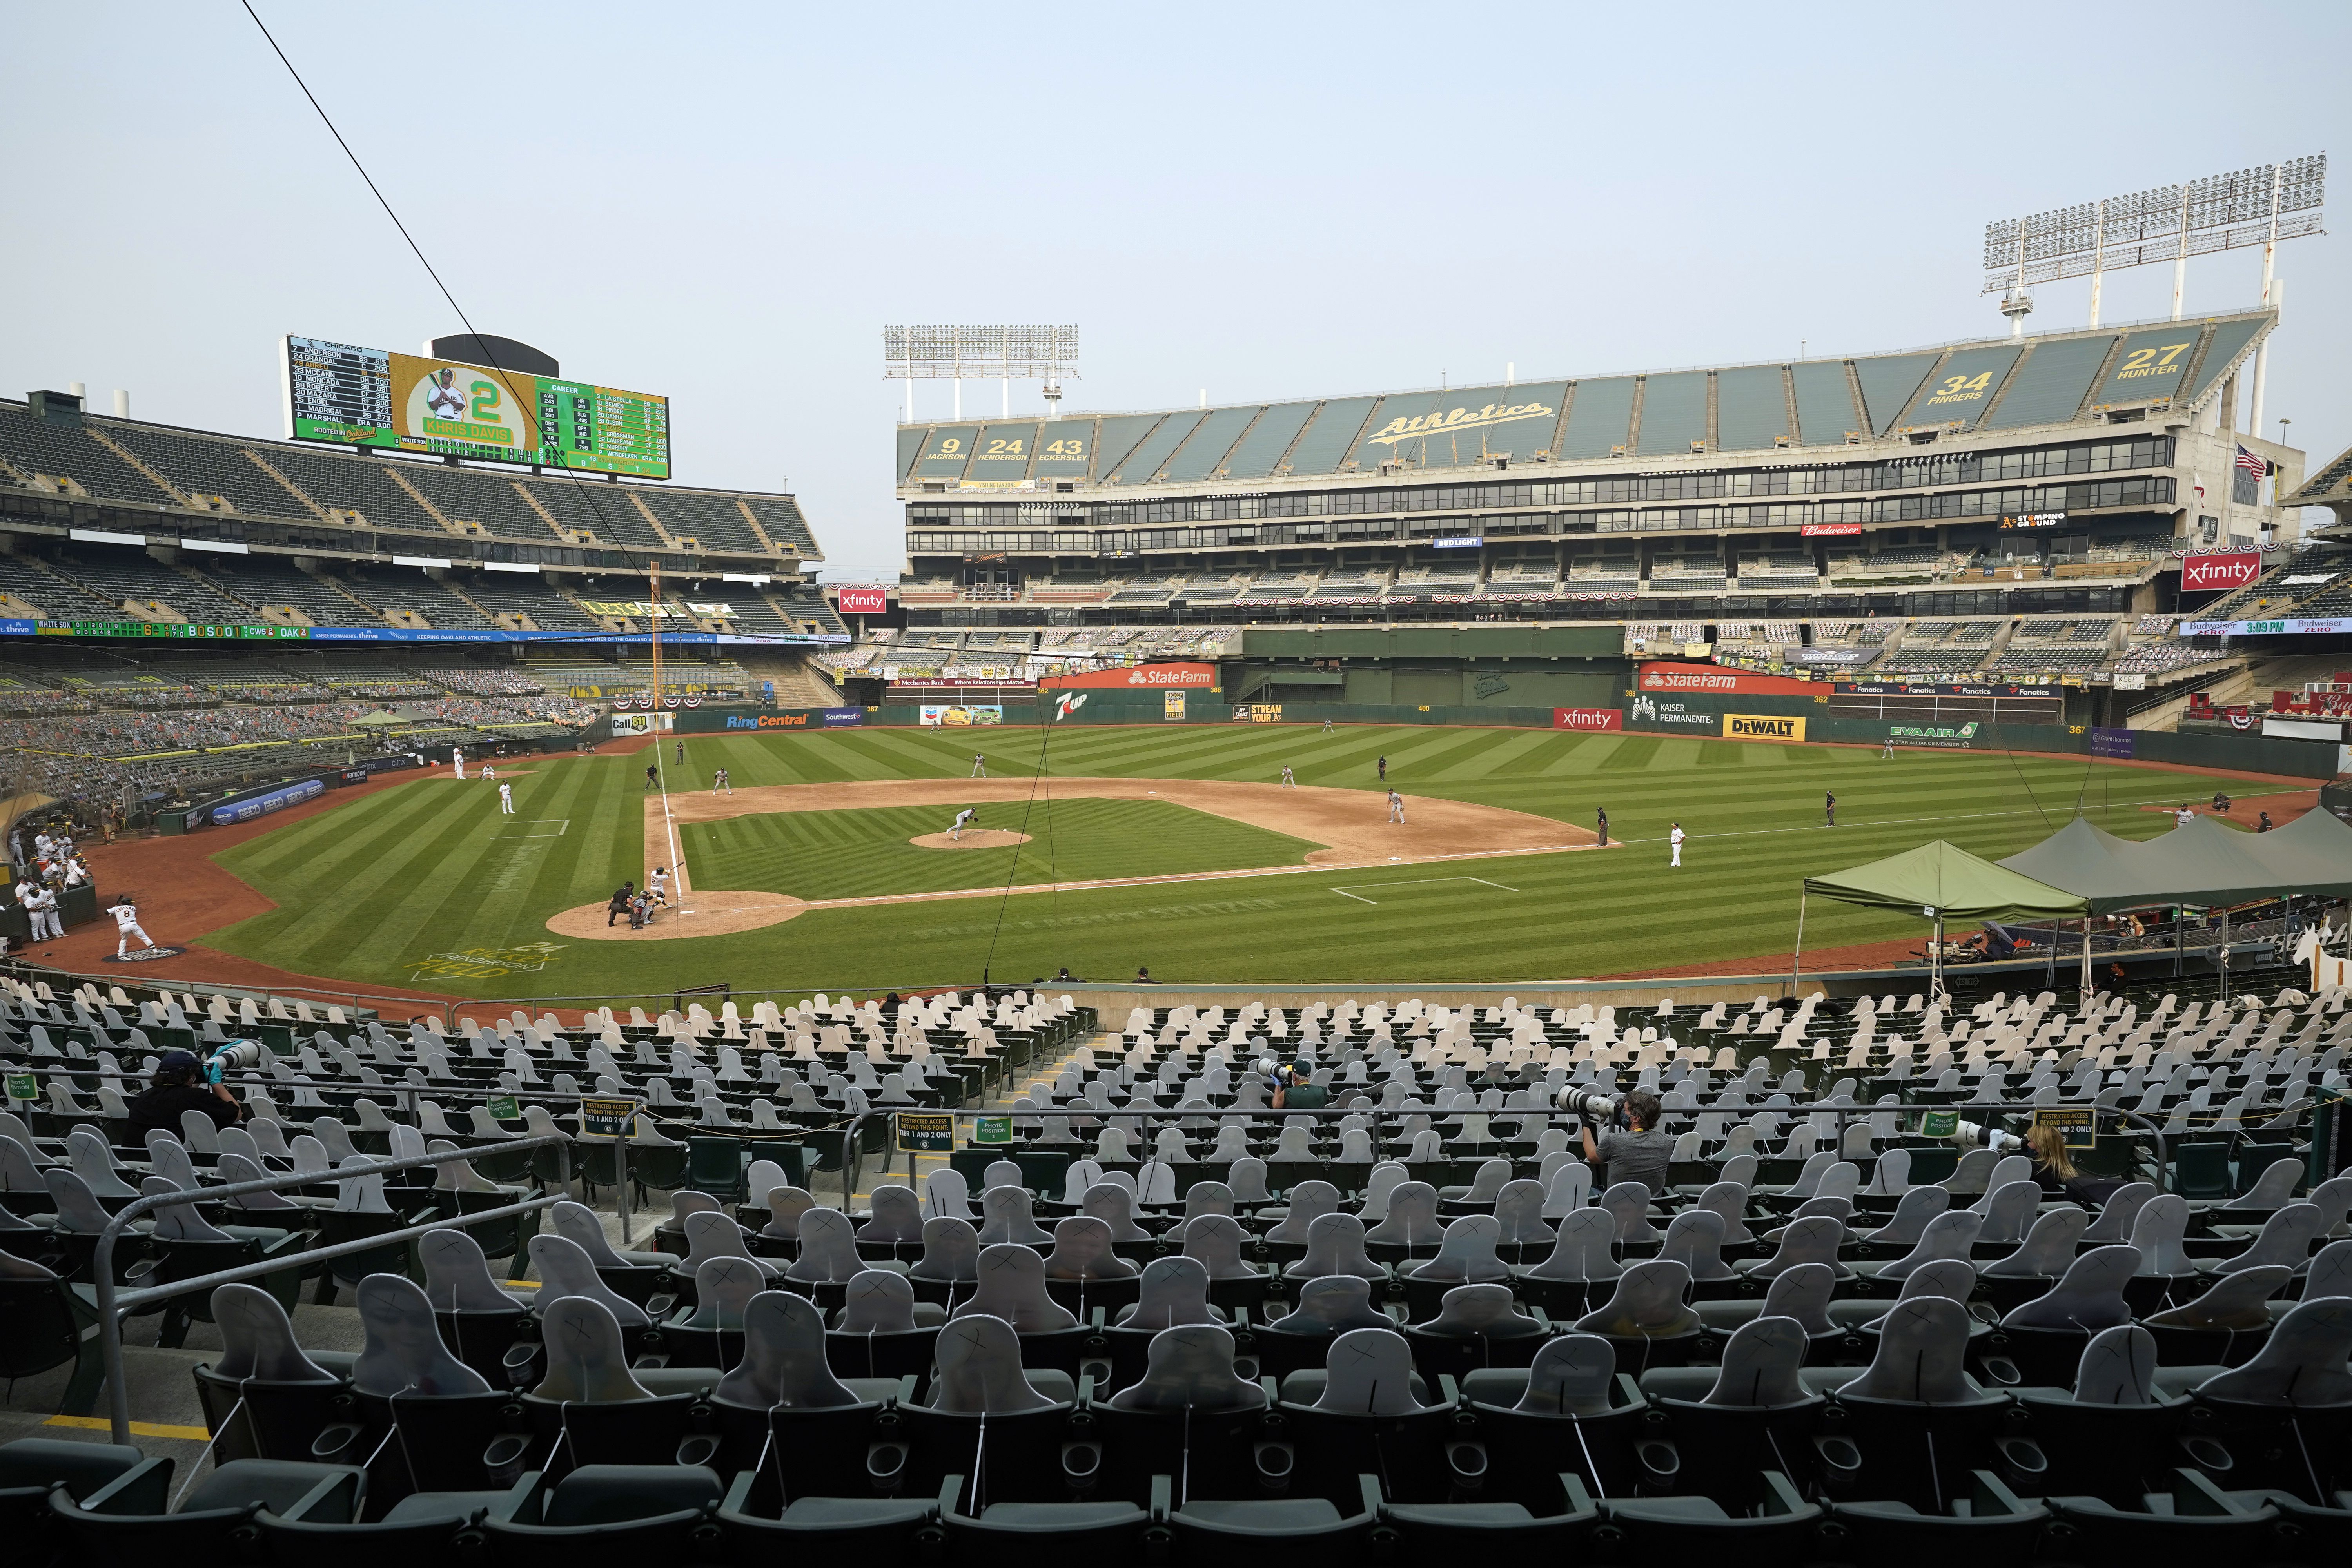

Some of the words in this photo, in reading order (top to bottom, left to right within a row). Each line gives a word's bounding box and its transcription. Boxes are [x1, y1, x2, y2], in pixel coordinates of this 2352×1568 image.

[304, 347, 341, 358] ANDERSON
[325, 343, 362, 352] CHICAGO
[305, 354, 337, 365] GRANDAL
[2122, 343, 2190, 370] 27
[305, 361, 328, 370] ABREU
[305, 368, 335, 378] MCCANN
[2117, 365, 2178, 379] HUNTER
[306, 376, 340, 386] MONCADA
[1936, 372, 1993, 395] 34
[307, 383, 334, 392] ROBERT
[552, 385, 578, 394] CAREER
[307, 390, 337, 399] MAZARA
[1927, 392, 1983, 405] FINGERS
[308, 397, 329, 406] ENGEL
[470, 380, 502, 423] 2
[308, 405, 343, 415] MADRIGAL
[307, 413, 344, 423] MARSHALL
[1368, 402, 1553, 445] Athletics
[314, 427, 338, 435] ROOTED
[347, 427, 376, 439] Oakland
[427, 420, 466, 435] KHRIS
[471, 426, 507, 440] DAVIS
[606, 431, 634, 439] GROSSMAN
[941, 439, 960, 453] 9
[987, 439, 1022, 454] 24
[1047, 440, 1082, 454] 43
[608, 451, 638, 459] WENDELKEN
[2000, 517, 2016, 528] A's
[2018, 513, 2065, 522] STOMPING
[1804, 526, 1858, 535] Budweiser
[975, 552, 1005, 564] Treehouse
[2188, 561, 2256, 583] xfinity
[843, 593, 883, 608] xfinity
[2189, 621, 2237, 630] Budweiser
[2247, 622, 2268, 633] 3:09
[2269, 622, 2284, 632] PM
[2298, 619, 2343, 627] Budweiser
[144, 624, 151, 635] 6
[281, 628, 299, 637] OAK
[1251, 705, 1282, 713] STREAM
[1661, 704, 1685, 712] KAISER
[613, 719, 630, 729] Call
[632, 716, 646, 726] 811
[728, 715, 807, 729] RingCentral
[1252, 713, 1271, 722] YOUR
[1272, 714, 1282, 722] A's
[1563, 710, 1611, 728] xfinity
[1660, 714, 1711, 724] PERMANENTE
[1733, 720, 1794, 735] DEWALT
[2069, 725, 2085, 734] 367
[392, 757, 405, 767] citrix
[287, 791, 304, 804] GEICO
[263, 797, 283, 811] GEICO
[238, 804, 260, 819] GEICO
[511, 942, 570, 954] 24
[460, 948, 560, 963] RICKEY
[440, 953, 537, 970] HENDERSON
[401, 959, 509, 978] FIELD
